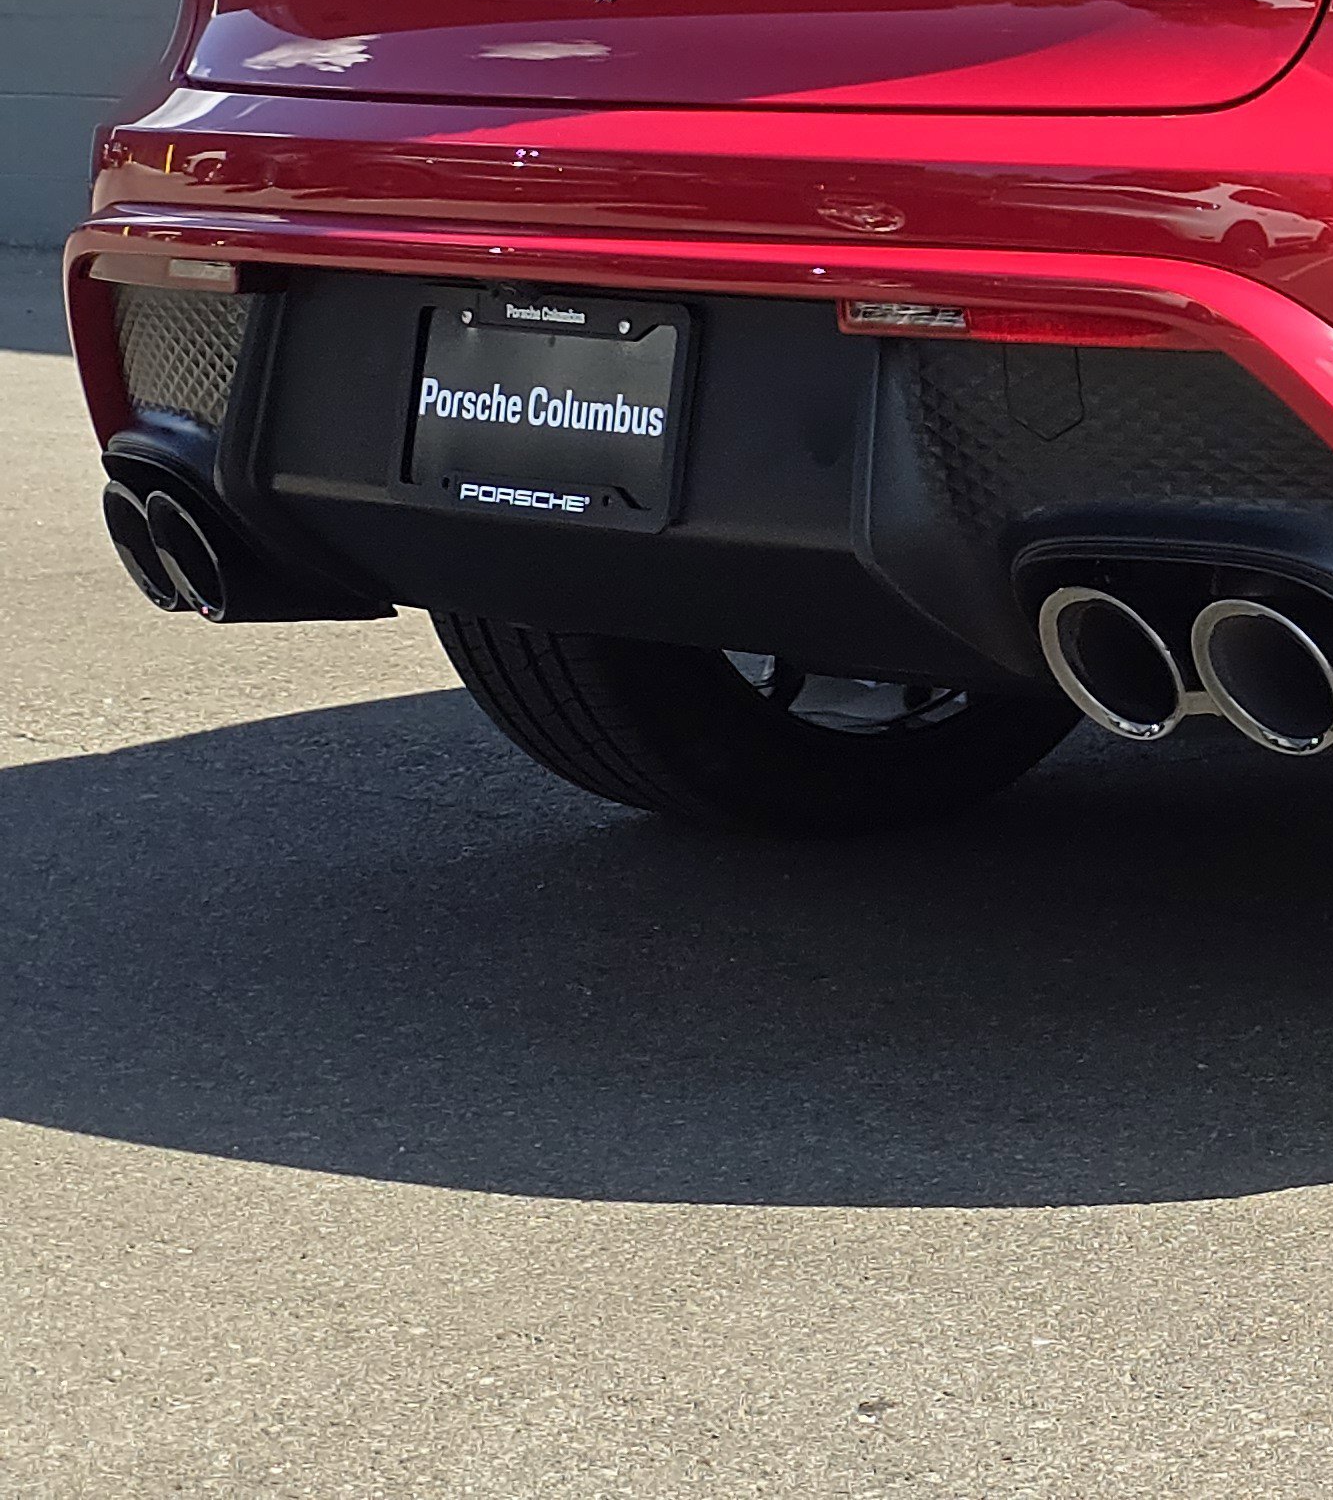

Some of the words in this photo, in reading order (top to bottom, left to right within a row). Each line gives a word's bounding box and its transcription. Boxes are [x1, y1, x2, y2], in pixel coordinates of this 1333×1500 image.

[419, 377, 522, 424] Porsche
[527, 386, 665, 437] Columbus
[460, 483, 585, 513] PORSCHE
